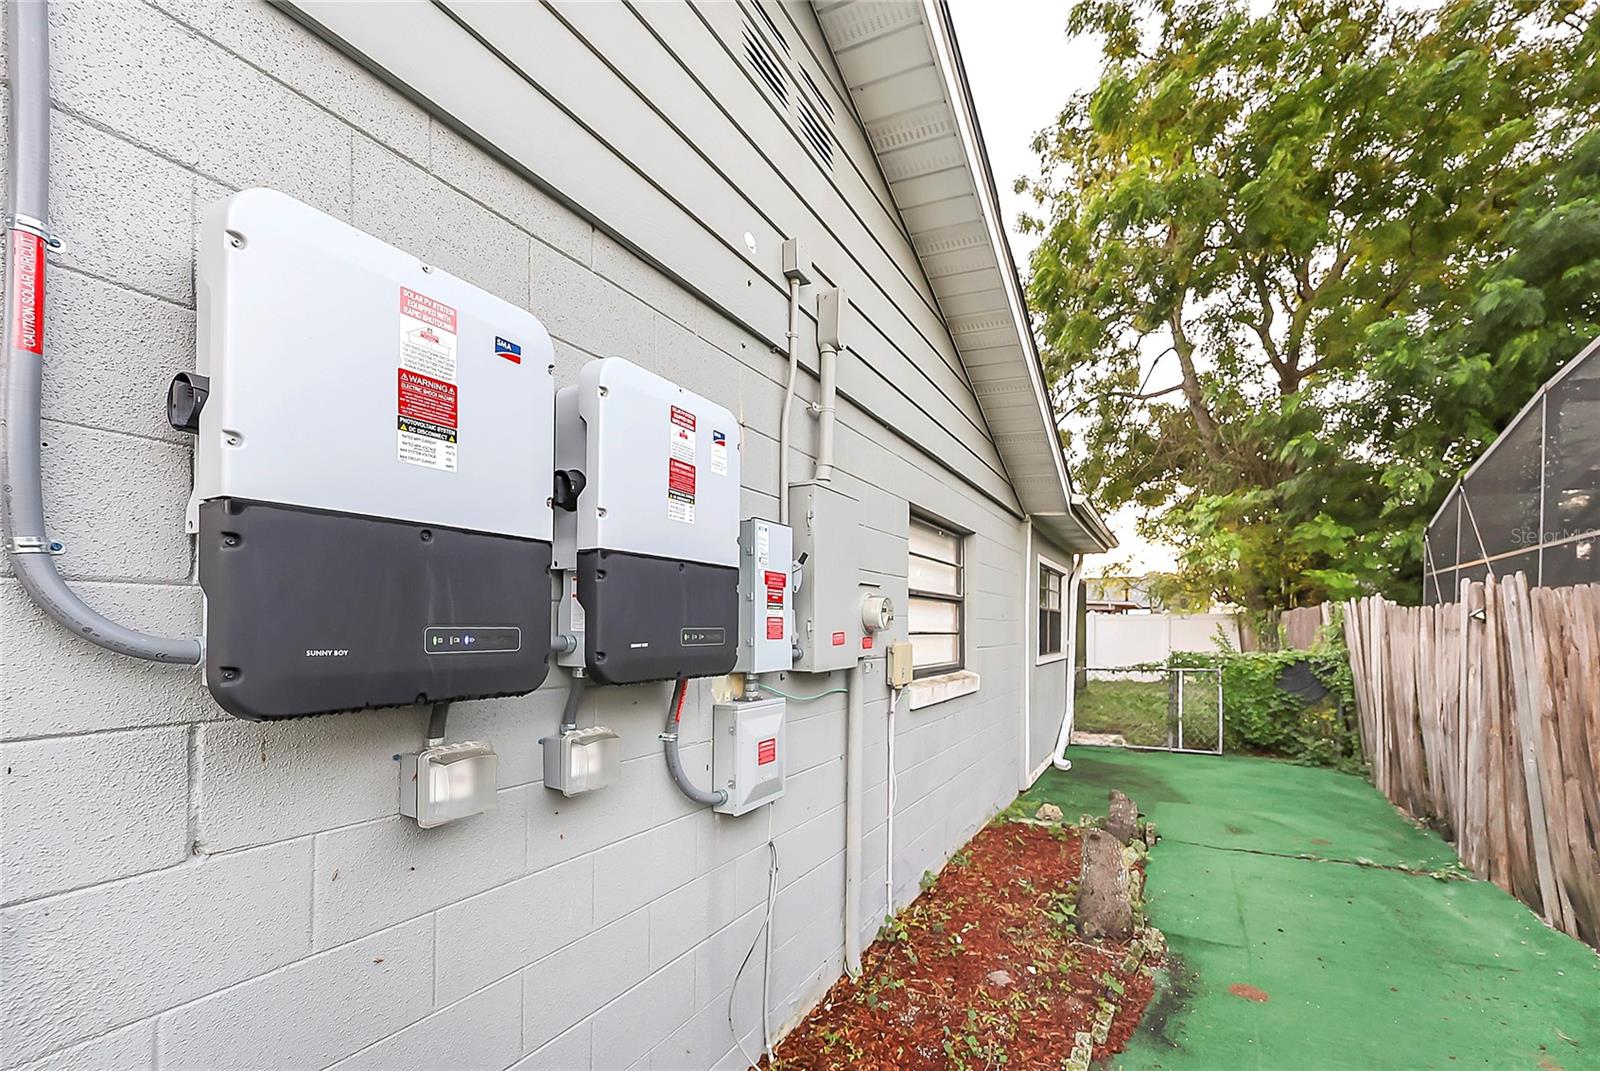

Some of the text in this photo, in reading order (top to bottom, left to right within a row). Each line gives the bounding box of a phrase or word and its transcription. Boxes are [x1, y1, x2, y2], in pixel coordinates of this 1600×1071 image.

[20, 235, 36, 348] CAUTION SOLAR CIRCUIT
[403, 289, 423, 303] SOLAR
[432, 302, 455, 316] SYSTEM
[407, 299, 451, 324] EQUIPPED WITH
[403, 306, 455, 332] RAPID SHUTDOWN
[497, 339, 512, 351] SMA
[401, 382, 422, 394] ELECTRIC
[423, 388, 438, 398] SHOCK
[439, 393, 455, 403] HAZARD
[408, 375, 448, 393] WARNING
[400, 417, 437, 431] PHOTOVOLTAIC
[437, 427, 456, 436] SYSTEM
[408, 426, 447, 440] DC DISCONNECT
